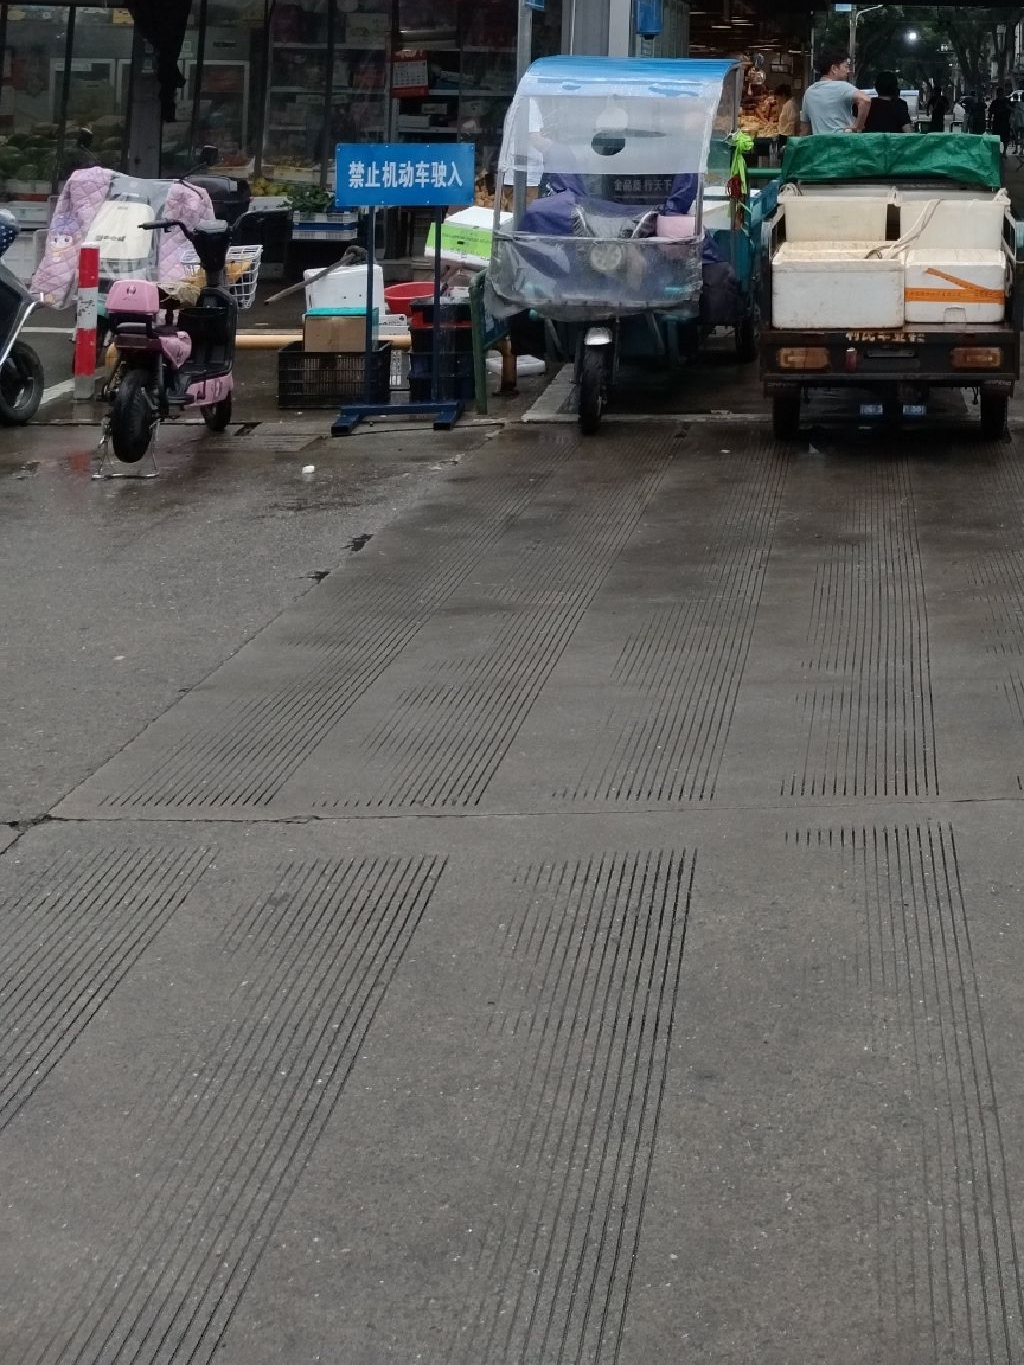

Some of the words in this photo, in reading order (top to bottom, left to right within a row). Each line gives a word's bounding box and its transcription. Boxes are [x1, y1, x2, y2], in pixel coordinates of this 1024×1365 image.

[349, 160, 464, 190] 禁止机动车驶入
